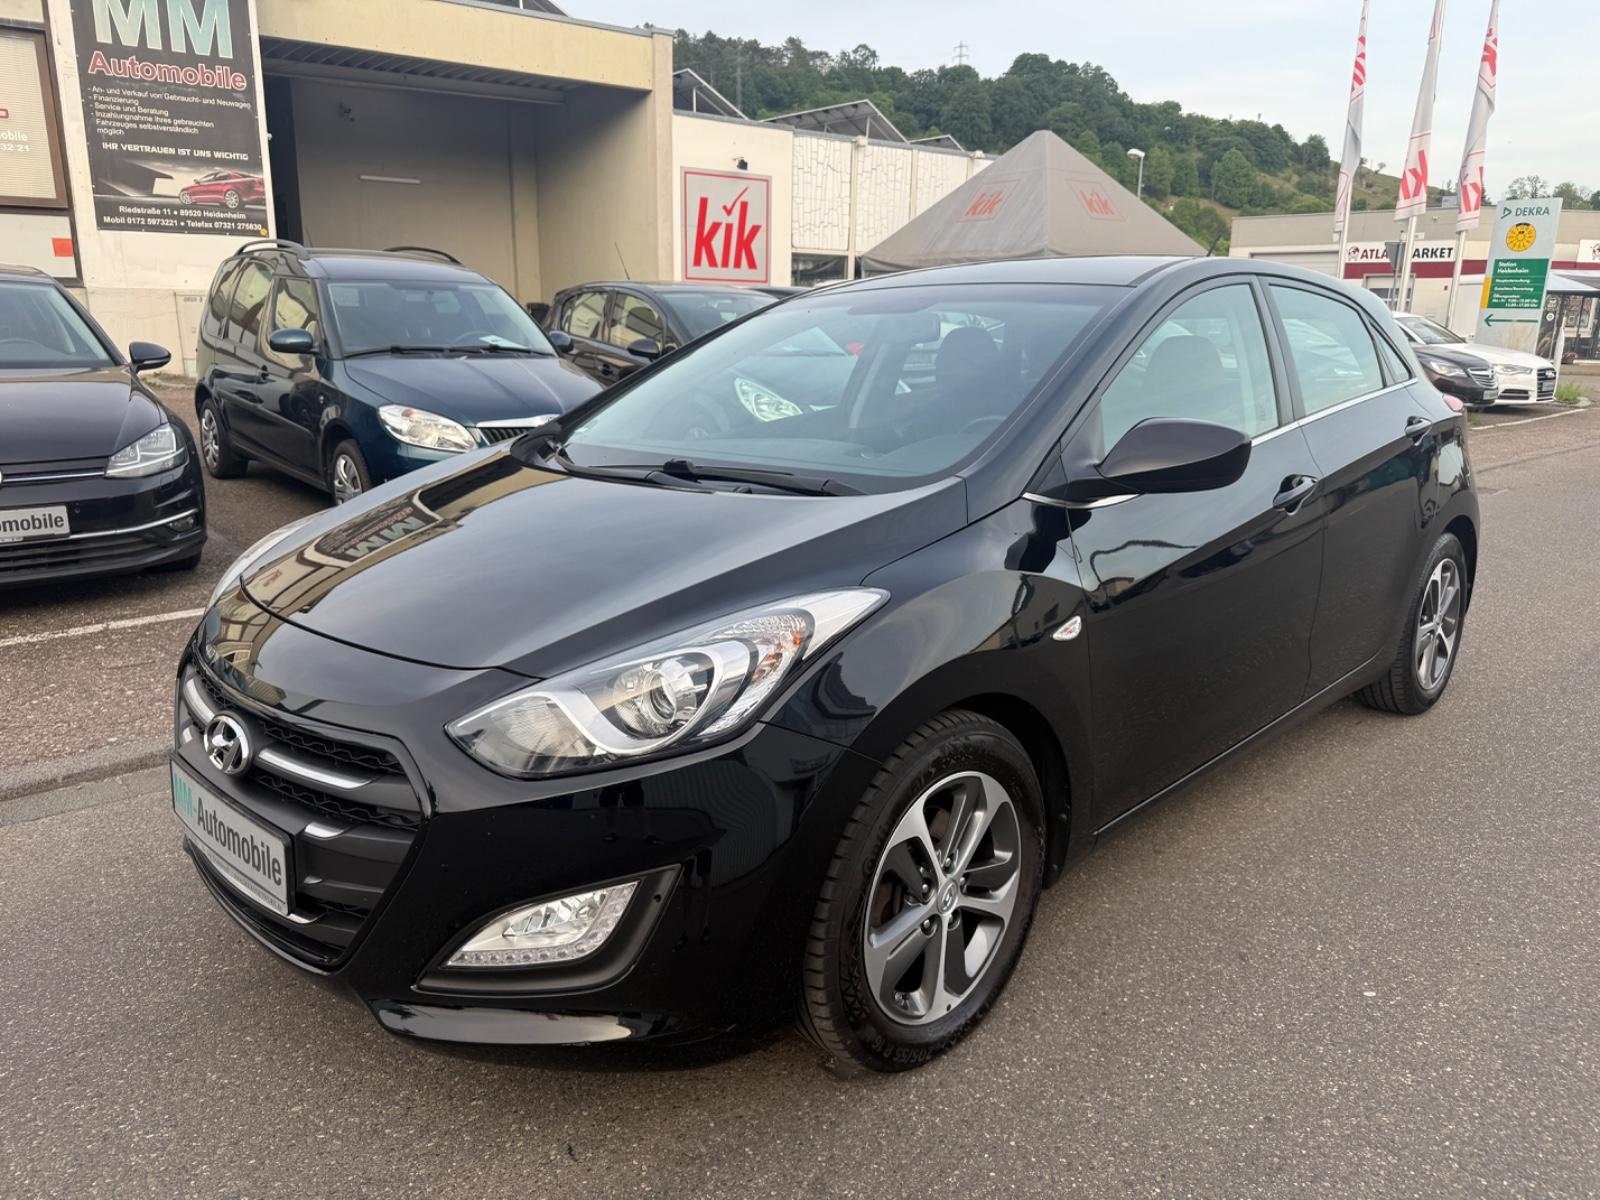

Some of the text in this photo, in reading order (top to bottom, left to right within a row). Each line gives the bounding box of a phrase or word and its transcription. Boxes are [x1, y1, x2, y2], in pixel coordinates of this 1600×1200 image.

[93, 0, 233, 58] MM
[88, 51, 247, 91] Automobile
[93, 93, 139, 105] Finanzierung
[122, 89, 149, 98] Verkauf
[94, 101, 121, 111] Service
[138, 106, 169, 117] Beratung
[97, 128, 125, 136] möglich
[102, 142, 249, 161] IHR VERTRAUEN IST UNS WICHTIG
[203, 210, 247, 219] Heidenheim
[1515, 206, 1550, 217] DEKRA
[103, 216, 125, 224] Mobil
[126, 217, 146, 225] 0172
[186, 220, 213, 228] Telefax
[693, 186, 762, 270] kik
[1360, 247, 1454, 260] ATLA ARKET
[0, 513, 65, 533] mobile
